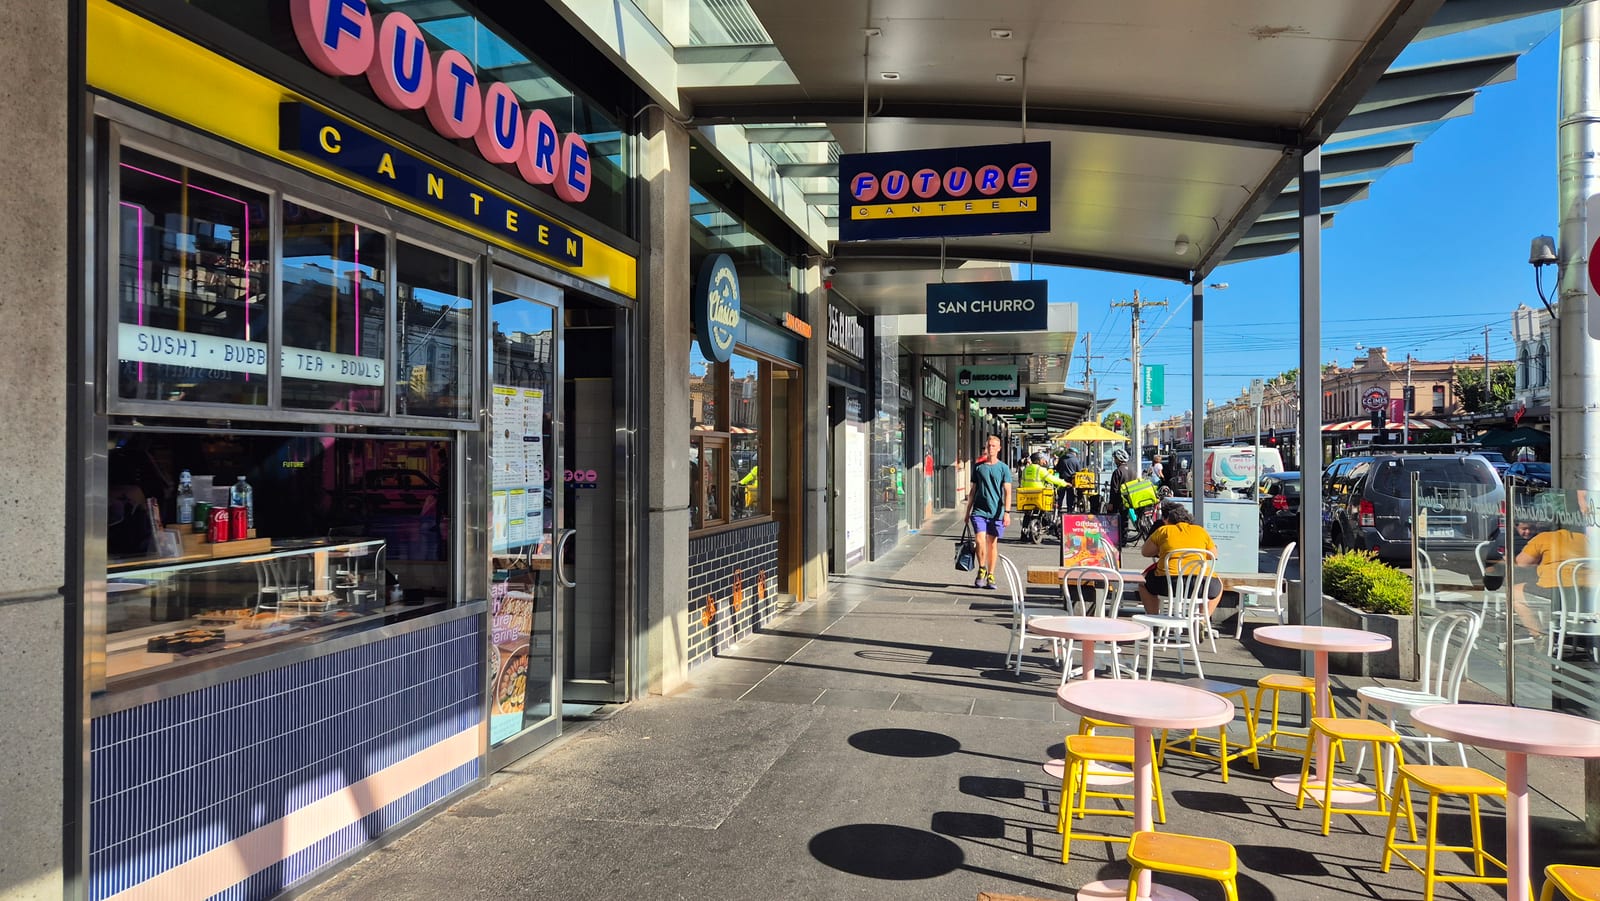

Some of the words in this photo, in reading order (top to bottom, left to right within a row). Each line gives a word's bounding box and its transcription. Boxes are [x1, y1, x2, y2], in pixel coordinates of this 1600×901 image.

[323, 0, 588, 193] FUTURE
[854, 166, 1033, 197] FUTURE
[319, 125, 577, 258] CANTEEN
[859, 200, 1029, 217] CANTEEN
[937, 301, 967, 314] SAN
[970, 298, 1035, 313] CHURRO
[137, 333, 197, 358] SUSHI
[223, 344, 285, 369] BUBB
[296, 354, 323, 372] TEA
[340, 359, 382, 379] BOWLS
[1206, 522, 1240, 530] ERCITY
[492, 580, 508, 597] ast
[492, 615, 511, 629] ure
[492, 627, 519, 643] ering
